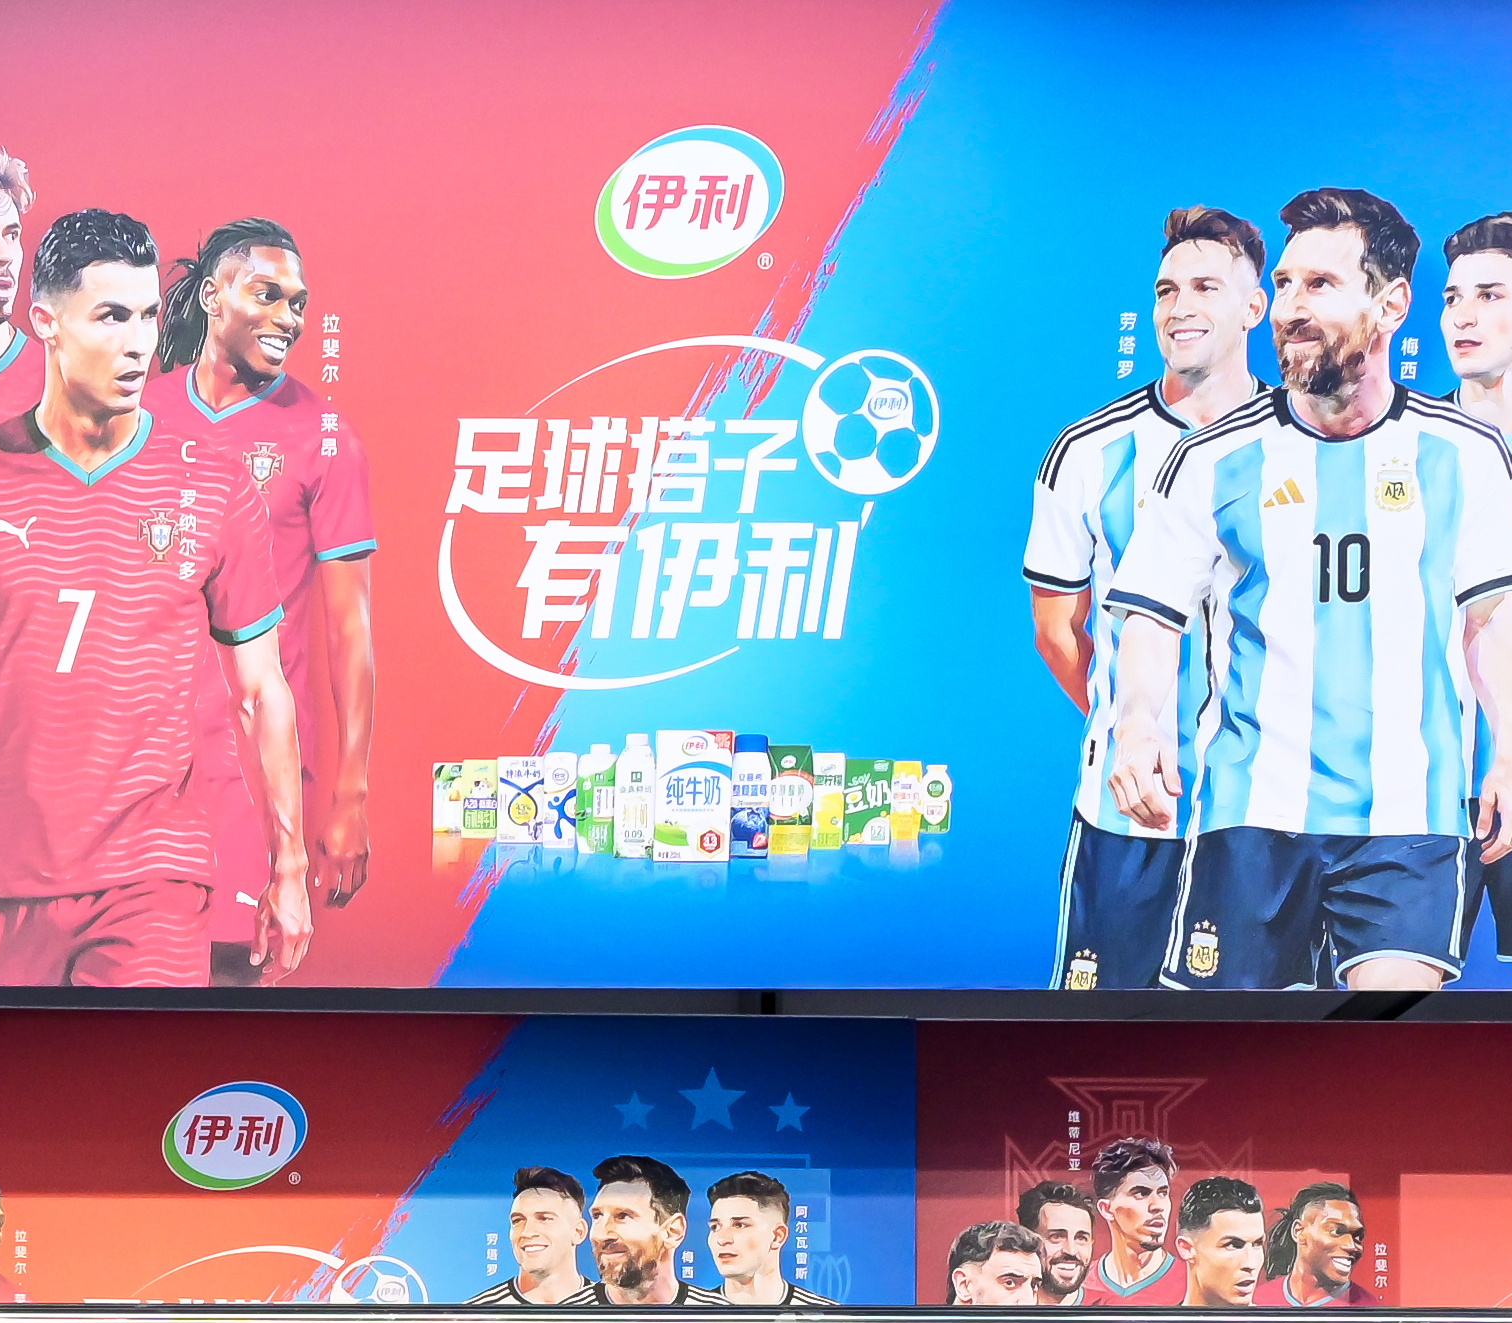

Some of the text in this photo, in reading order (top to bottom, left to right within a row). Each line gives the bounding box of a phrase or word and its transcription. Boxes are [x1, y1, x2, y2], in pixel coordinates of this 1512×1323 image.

[622, 173, 754, 231] 伊利
[1118, 312, 1137, 381] 劳塔罗
[1399, 335, 1419, 381] 梅西
[321, 314, 341, 458] 拉斐尔·莱昂
[445, 417, 800, 515] 足球搭子
[517, 502, 871, 642] 有伊利
[1312, 532, 1370, 603] 10
[56, 589, 96, 673] 7
[665, 773, 722, 806] 纯牛奶
